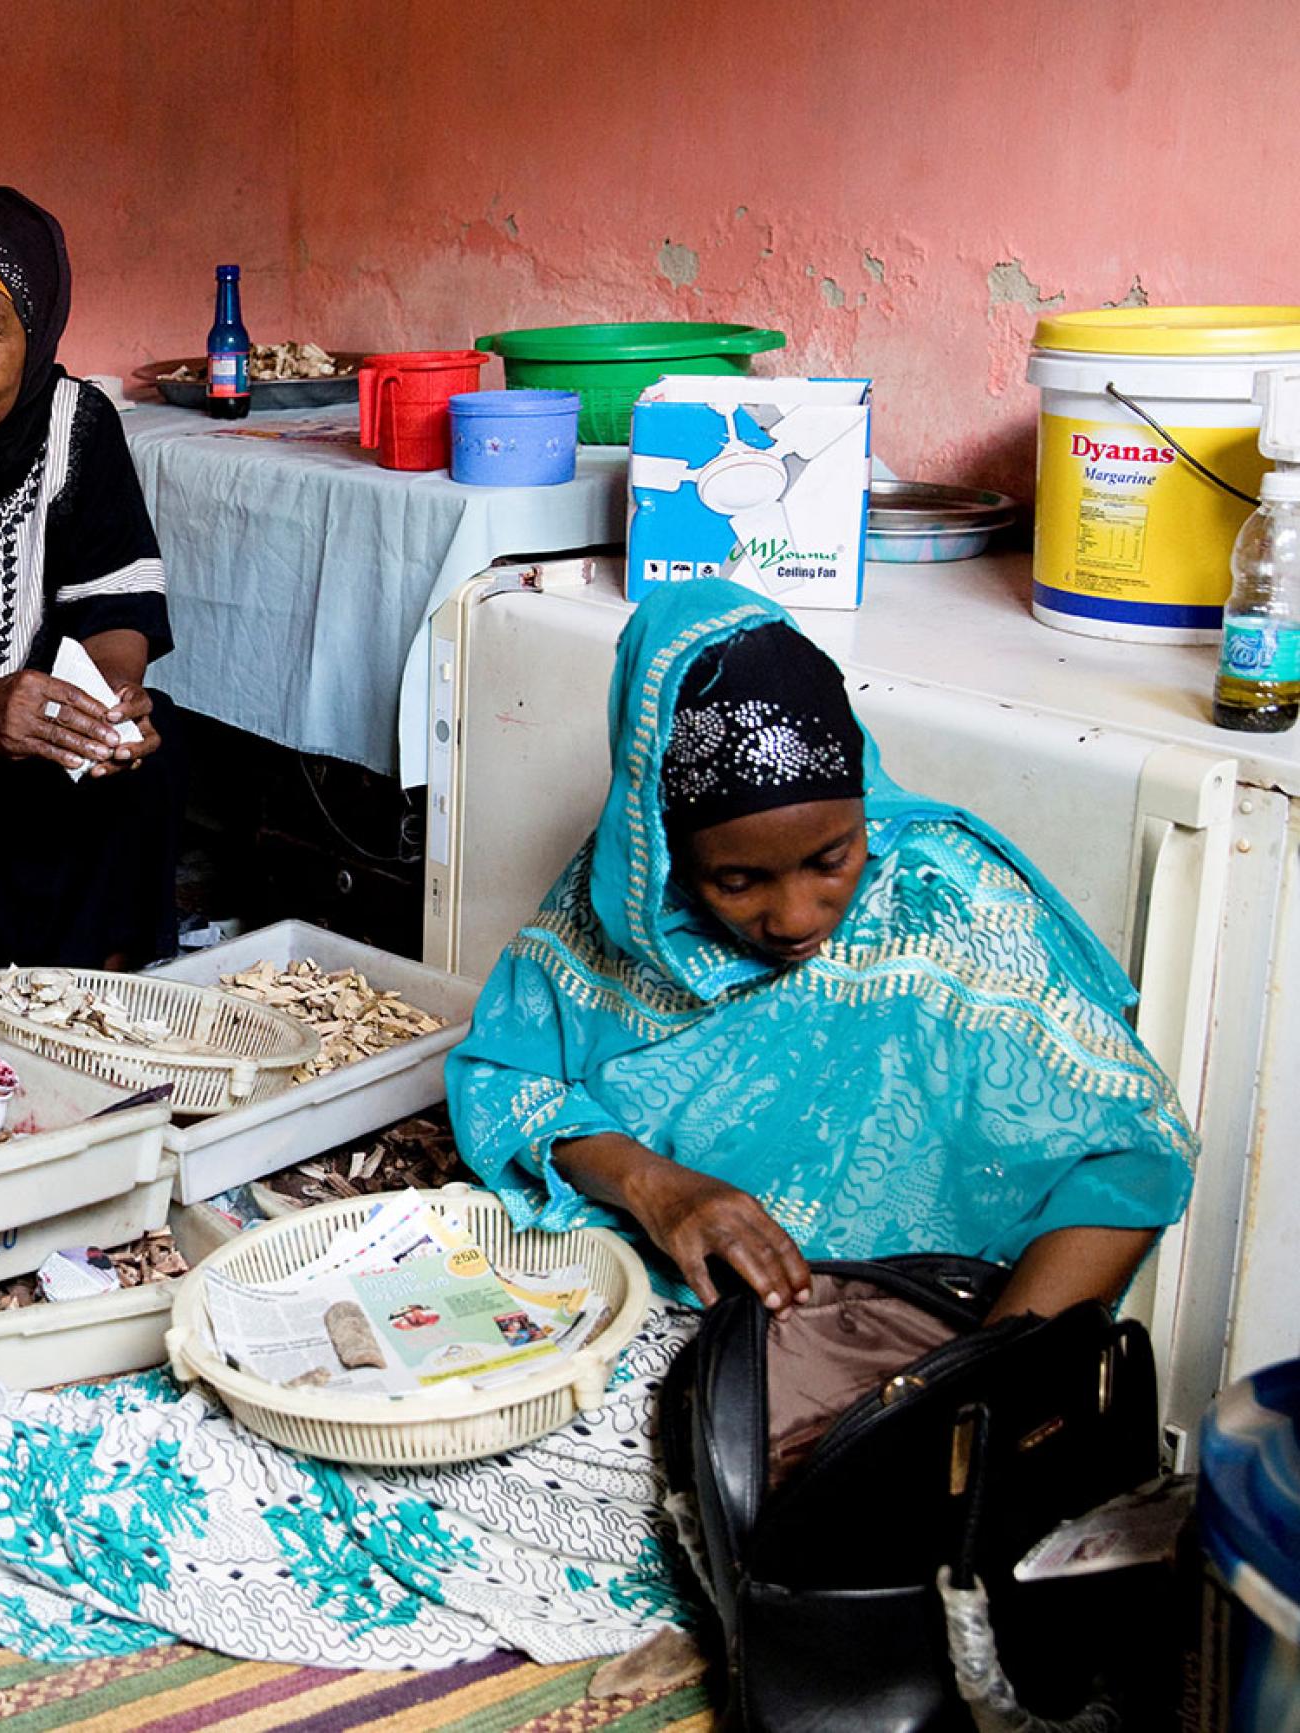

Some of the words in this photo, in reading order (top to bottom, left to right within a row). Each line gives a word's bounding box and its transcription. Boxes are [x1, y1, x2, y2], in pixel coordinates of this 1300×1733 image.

[1071, 434, 1176, 463] Dyanas
[1084, 467, 1157, 485] Margarine
[777, 566, 815, 579] Ceiling
[818, 567, 836, 578] Fan
